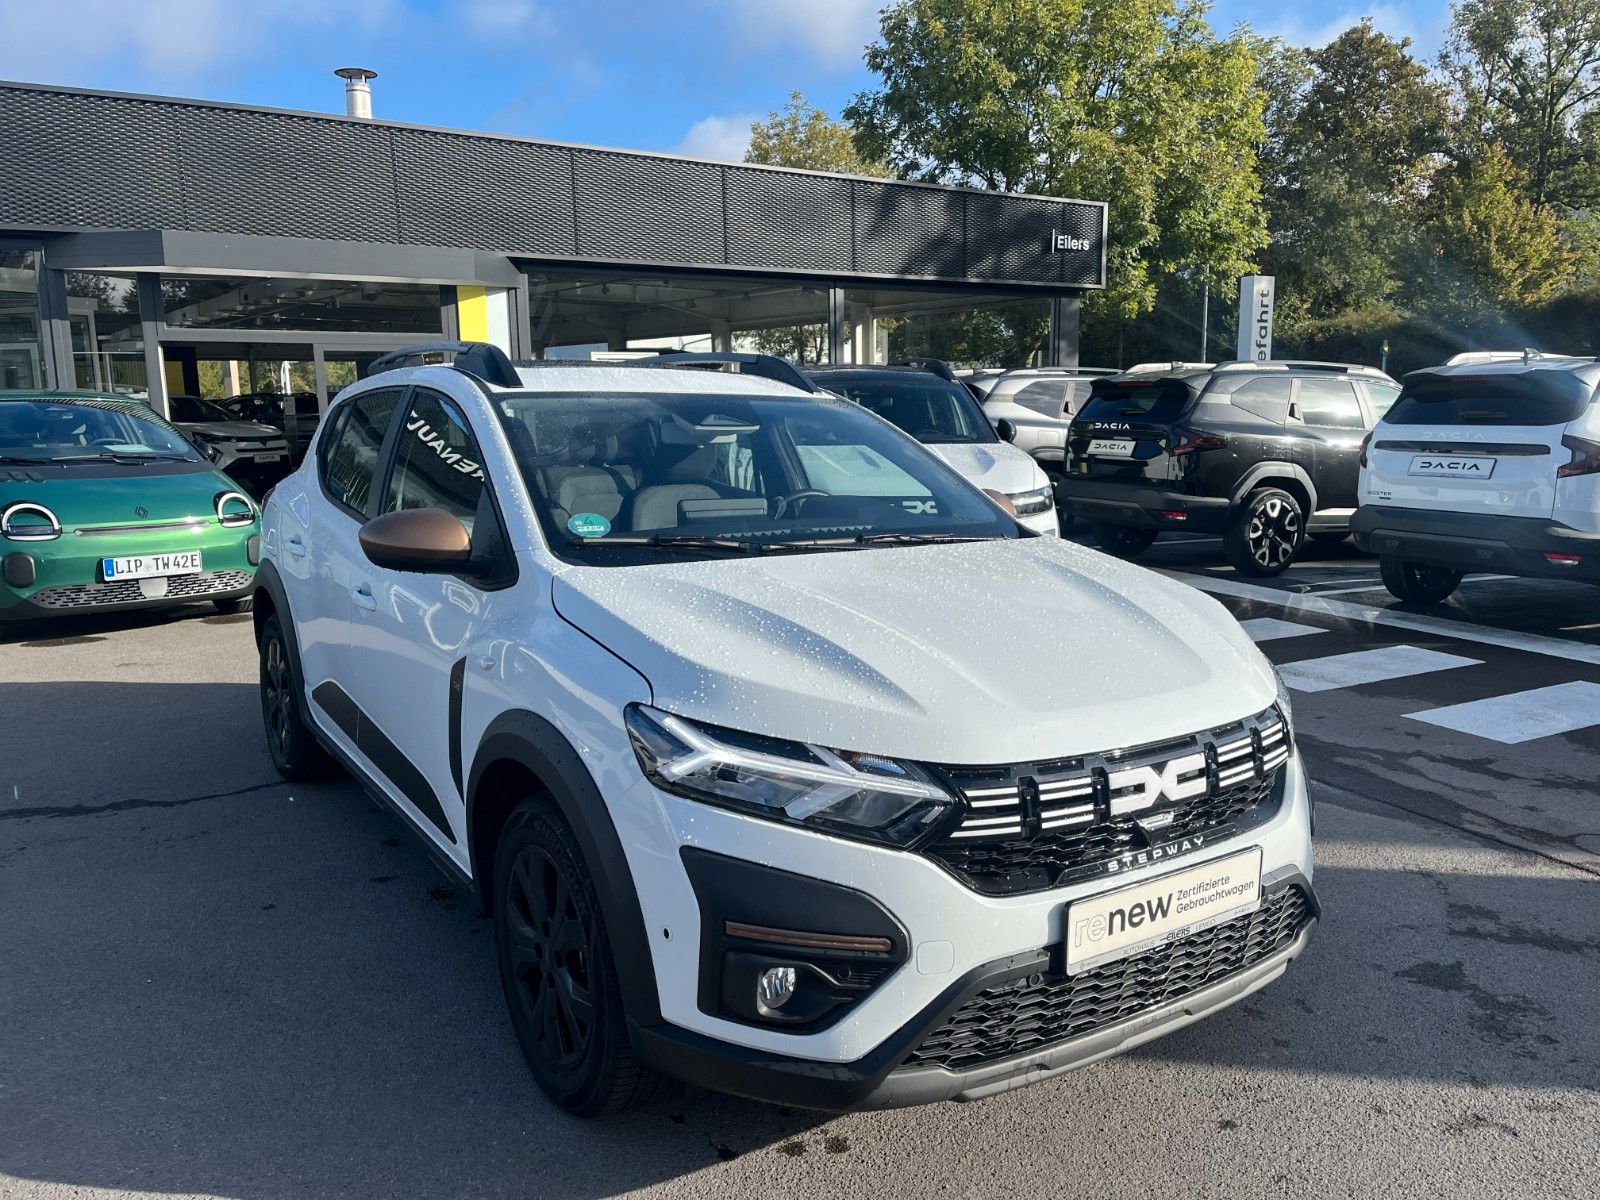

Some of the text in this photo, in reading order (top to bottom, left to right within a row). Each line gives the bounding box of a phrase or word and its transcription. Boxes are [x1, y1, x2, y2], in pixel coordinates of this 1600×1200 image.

[1057, 235, 1090, 250] Eilers
[1255, 289, 1270, 360] efahrt
[1094, 422, 1130, 430] DACIA
[1422, 431, 1486, 440] DACIA
[1419, 461, 1480, 471] DACIA
[115, 559, 143, 574] LIP
[1107, 836, 1204, 872] STEPWAY
[1176, 875, 1230, 901] Zertifizierte
[1176, 880, 1255, 914] Gebrauchtwagen
[1074, 892, 1174, 948] renew
